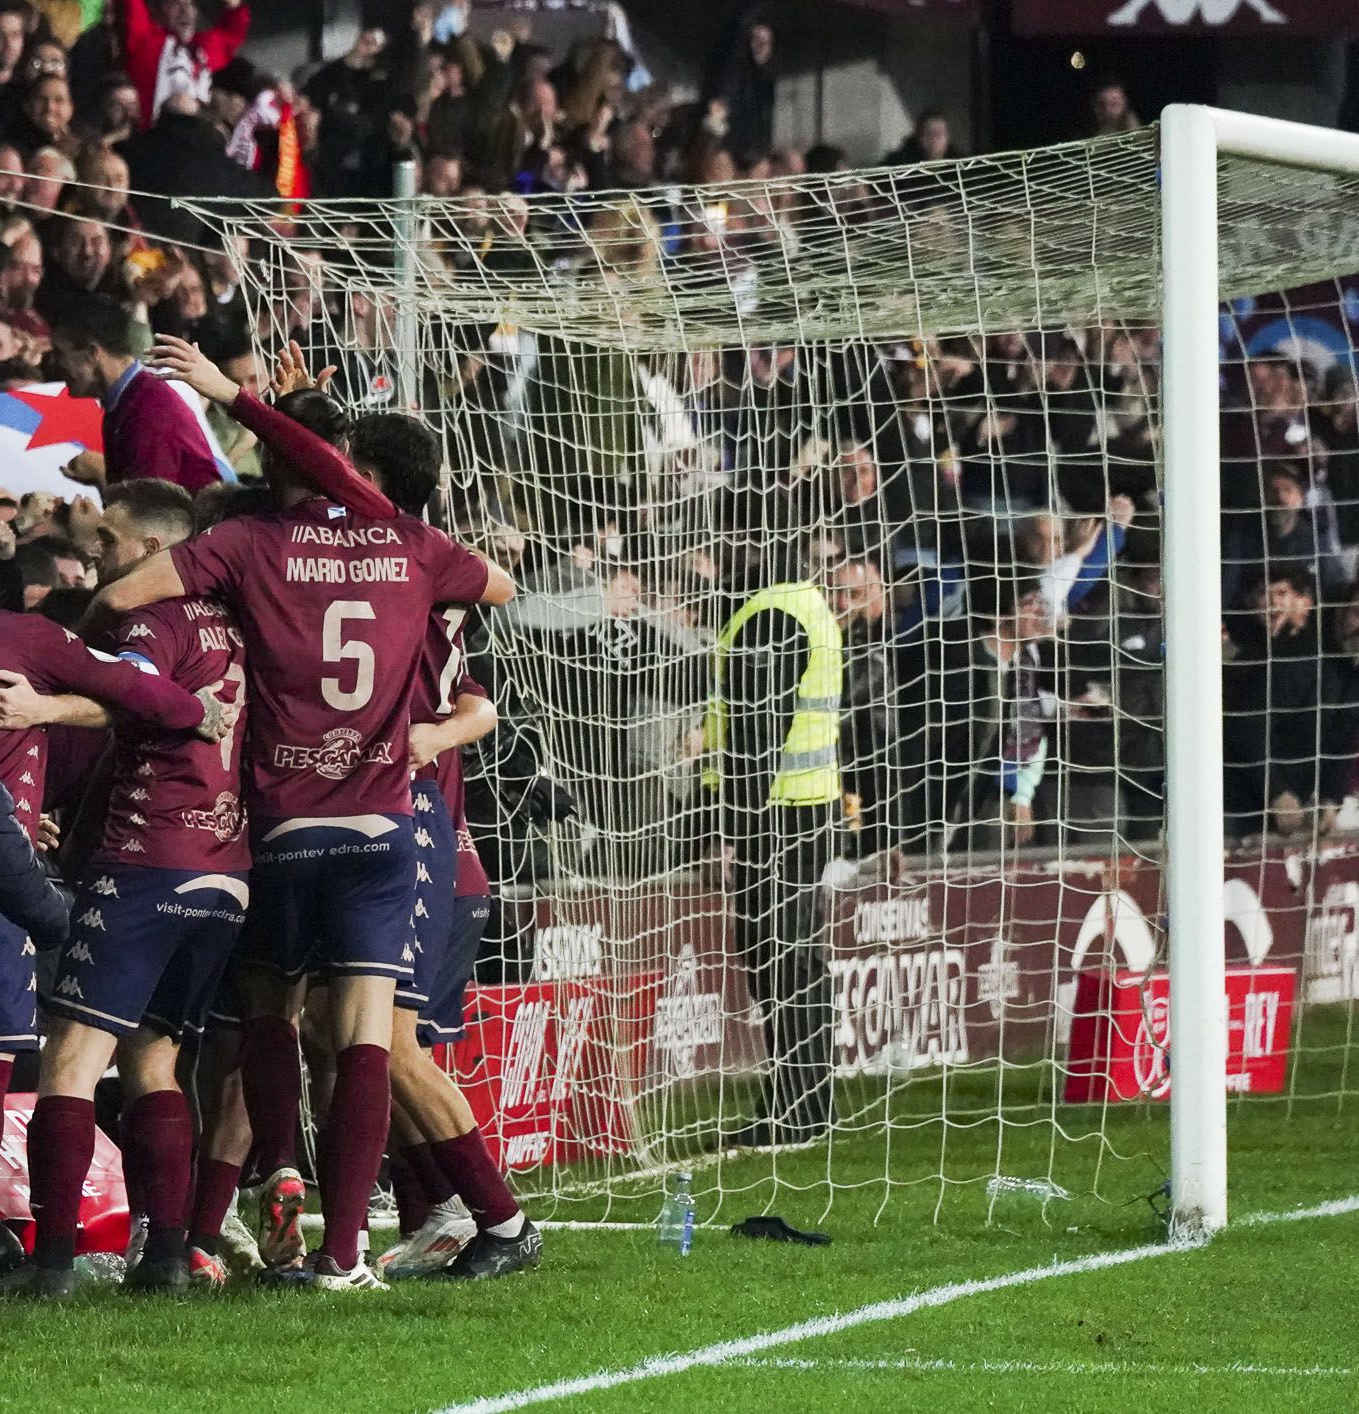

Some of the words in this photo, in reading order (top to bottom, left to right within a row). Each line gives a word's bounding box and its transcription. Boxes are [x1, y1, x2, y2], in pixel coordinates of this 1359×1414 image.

[286, 557, 346, 584] MARIO
[349, 557, 410, 583] GOMEZ
[321, 600, 376, 712] 5
